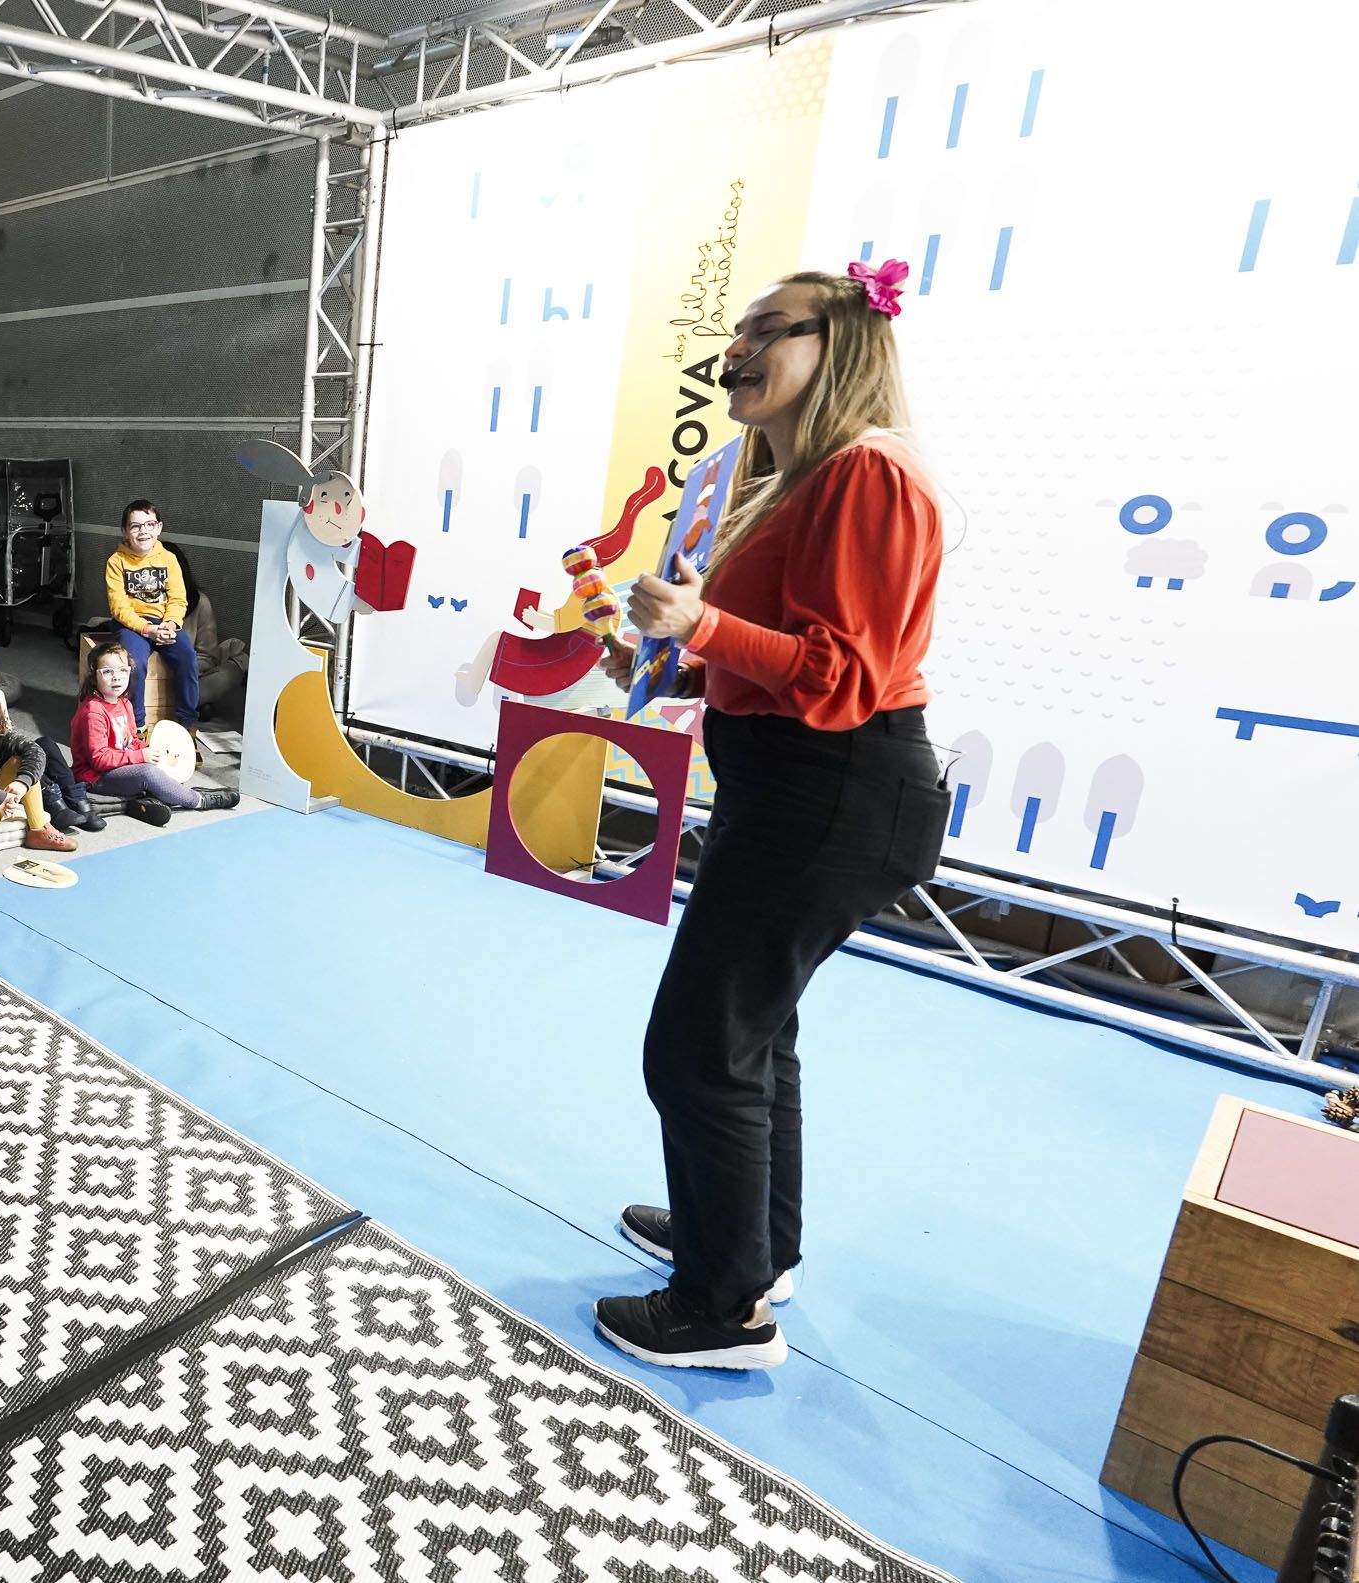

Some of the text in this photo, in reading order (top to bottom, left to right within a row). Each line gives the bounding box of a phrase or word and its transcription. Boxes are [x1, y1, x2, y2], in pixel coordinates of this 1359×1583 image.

[662, 243, 712, 362] dos libros
[125, 569, 167, 582] TOCH
